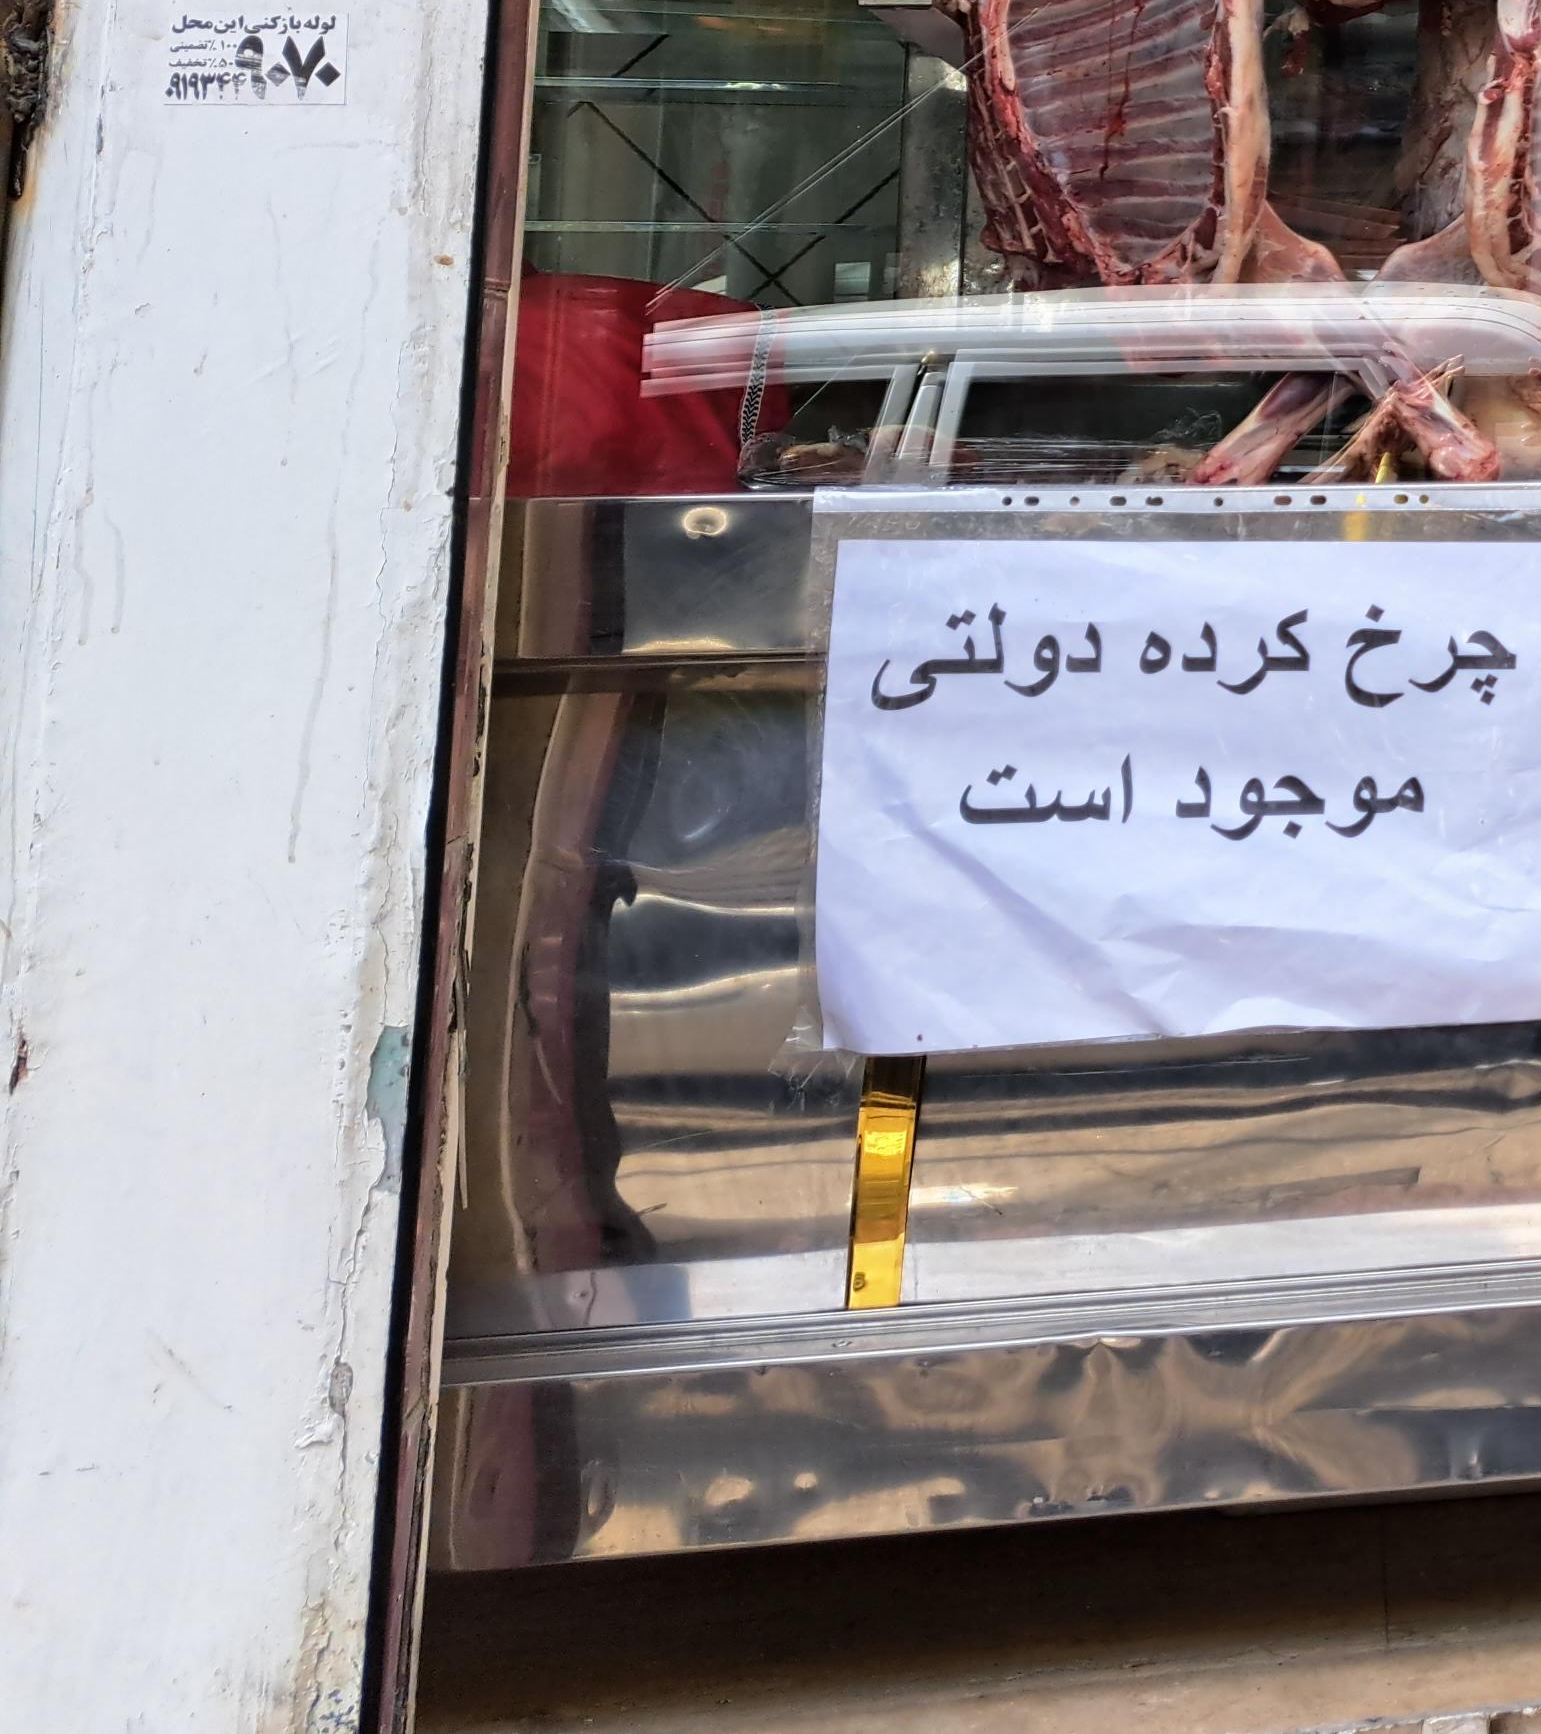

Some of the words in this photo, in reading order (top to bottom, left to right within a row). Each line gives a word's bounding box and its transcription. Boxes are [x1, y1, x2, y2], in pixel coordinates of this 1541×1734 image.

[244, 13, 303, 34] بازکنی
[303, 14, 337, 34] لوله
[168, 57, 207, 68] تخفیف
[871, 602, 1101, 711] دولتی
[1138, 607, 1311, 697] کرده
[1345, 603, 1517, 709] چرخ
[959, 753, 1133, 826] است
[1175, 765, 1425, 842] موجود
